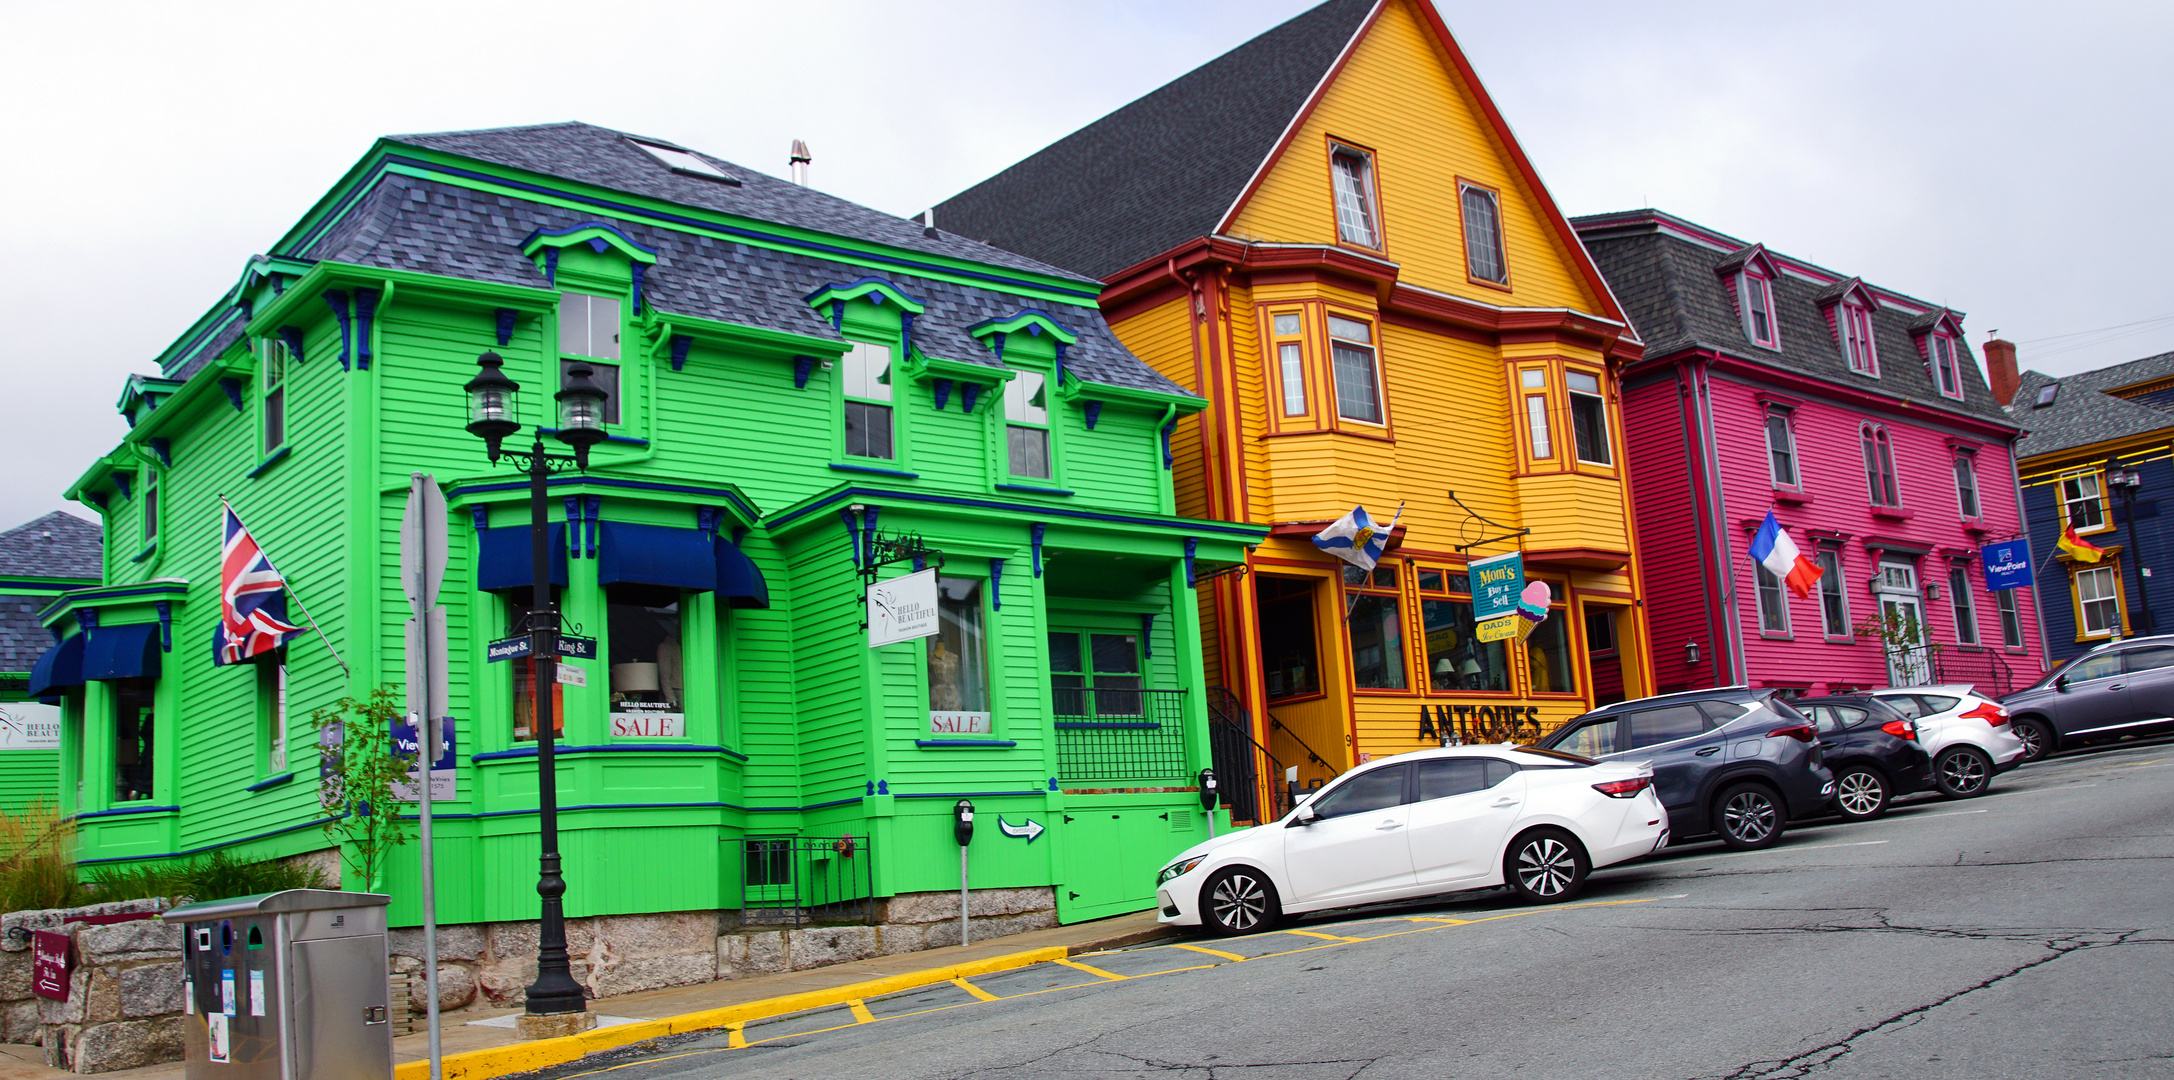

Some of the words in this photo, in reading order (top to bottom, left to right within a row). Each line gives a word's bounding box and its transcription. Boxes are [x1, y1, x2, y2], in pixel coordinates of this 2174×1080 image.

[1988, 561, 2026, 573] ViewPoint
[1479, 565, 1515, 587] Mom's
[1487, 586, 1502, 598] Buy
[1493, 595, 1509, 608] Sell
[897, 602, 920, 616] HELLO
[897, 607, 937, 624] BEAUTIFUL
[1483, 619, 1511, 631] DAD'S
[489, 645, 518, 657] Montague
[558, 640, 575, 654] King
[614, 717, 674, 737] SALE
[931, 715, 981, 733] SALE
[1419, 704, 1541, 740] ANTIQUES
[398, 739, 450, 751] Vient
[1345, 734, 1352, 747] 9
